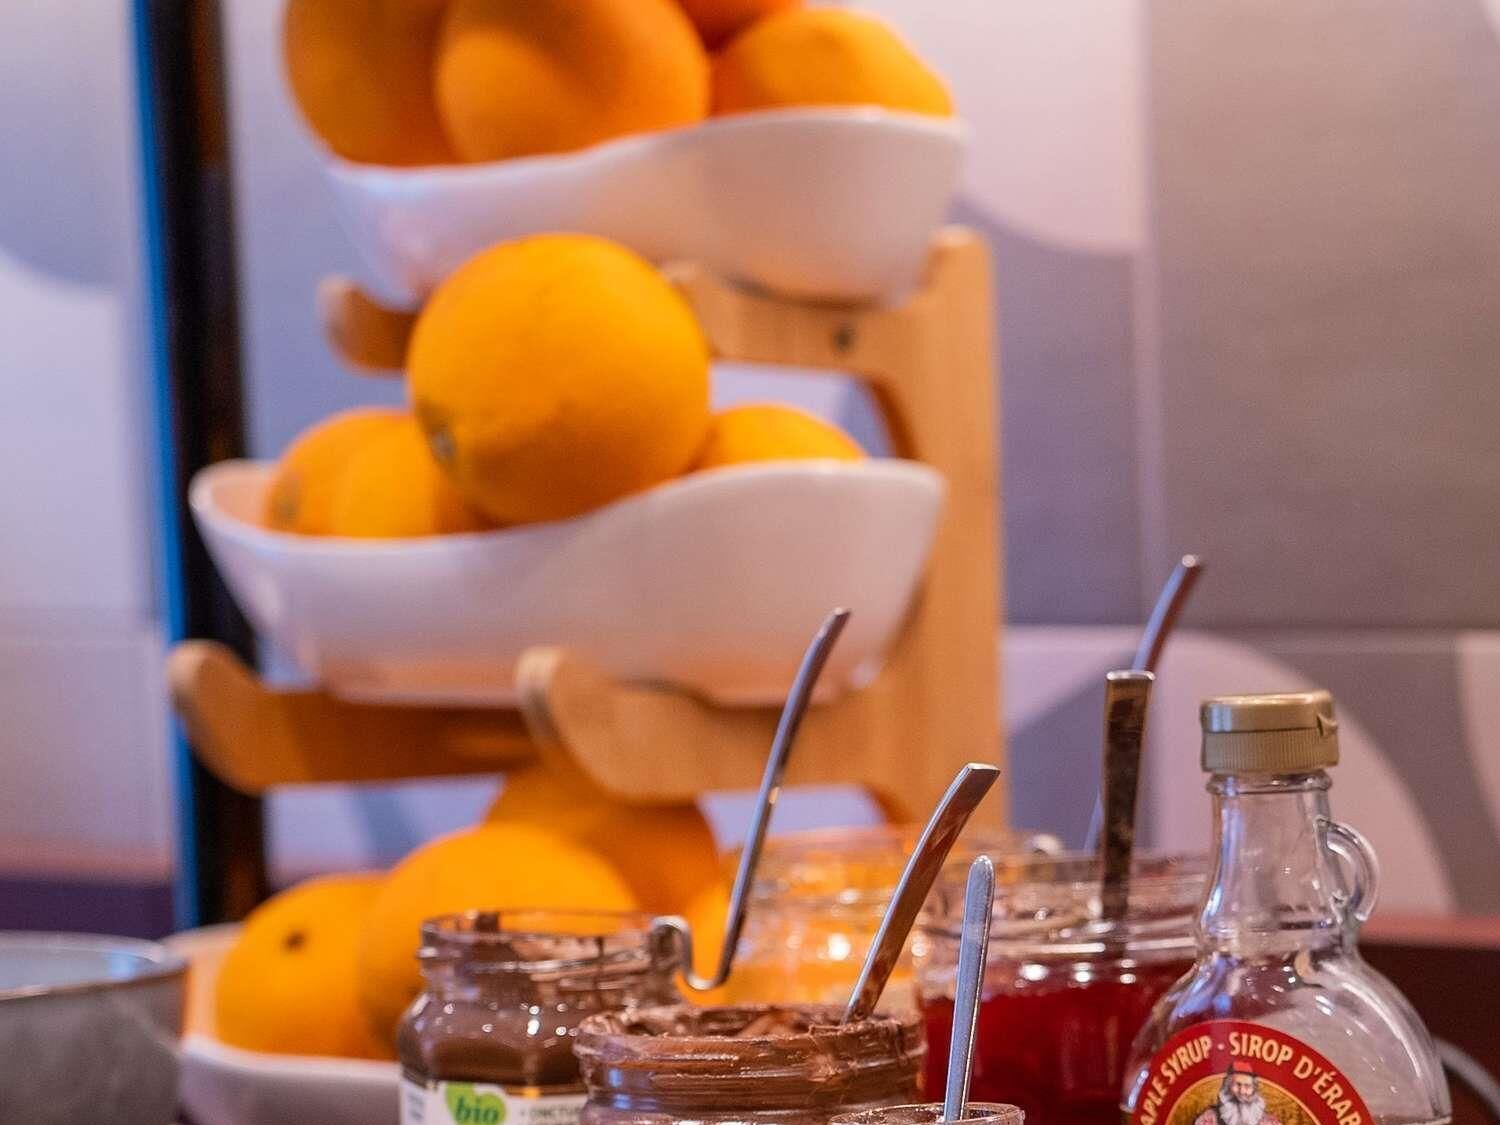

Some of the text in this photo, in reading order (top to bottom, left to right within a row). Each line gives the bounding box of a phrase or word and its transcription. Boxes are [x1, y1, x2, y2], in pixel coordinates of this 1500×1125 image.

[1160, 1034, 1212, 1084] SYRUP
[1229, 1031, 1294, 1066] SIROP
[455, 1095, 501, 1125] bio
